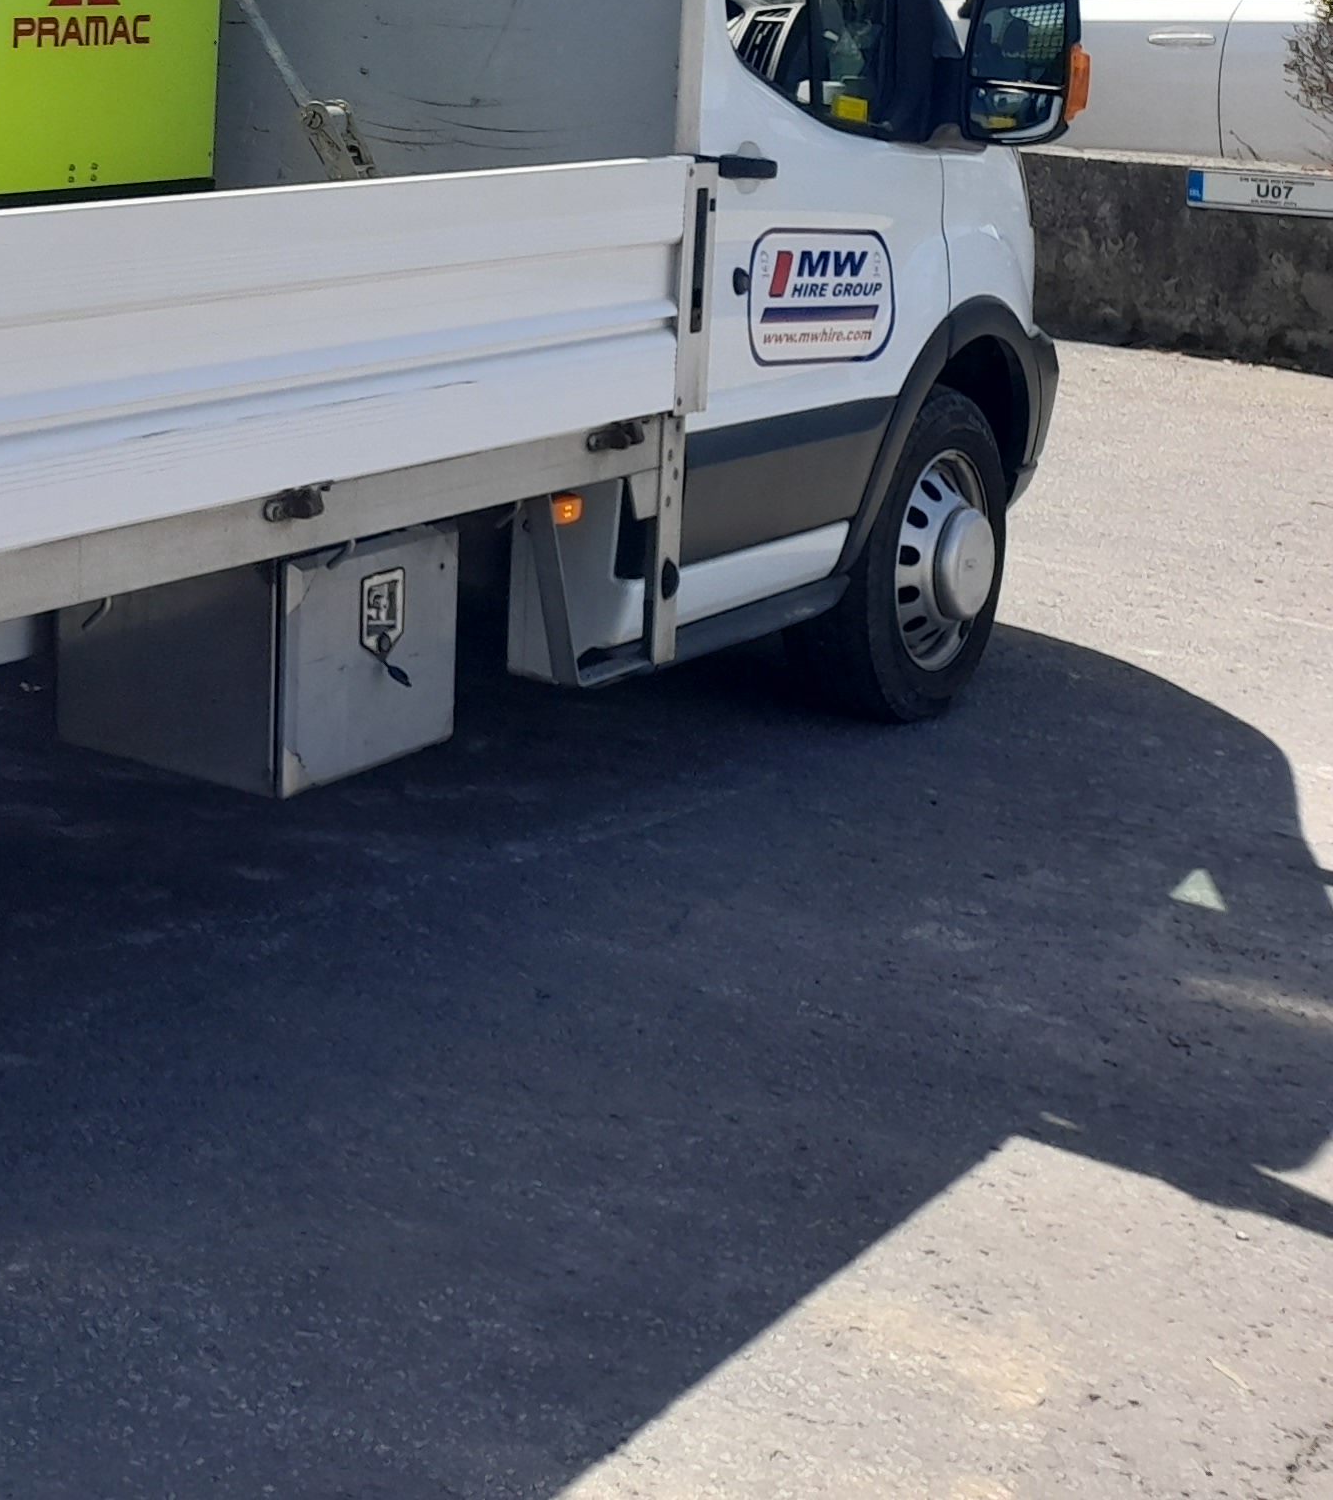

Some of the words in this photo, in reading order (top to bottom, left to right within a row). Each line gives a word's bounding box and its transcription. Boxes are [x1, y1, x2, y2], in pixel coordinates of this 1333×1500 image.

[12, 14, 151, 49] PRAMAC
[1256, 183, 1293, 199] U07
[797, 250, 868, 277] MW
[791, 283, 829, 298] HIRE
[832, 282, 883, 297] GROUP
[763, 327, 873, 344] www.mwhire.com
